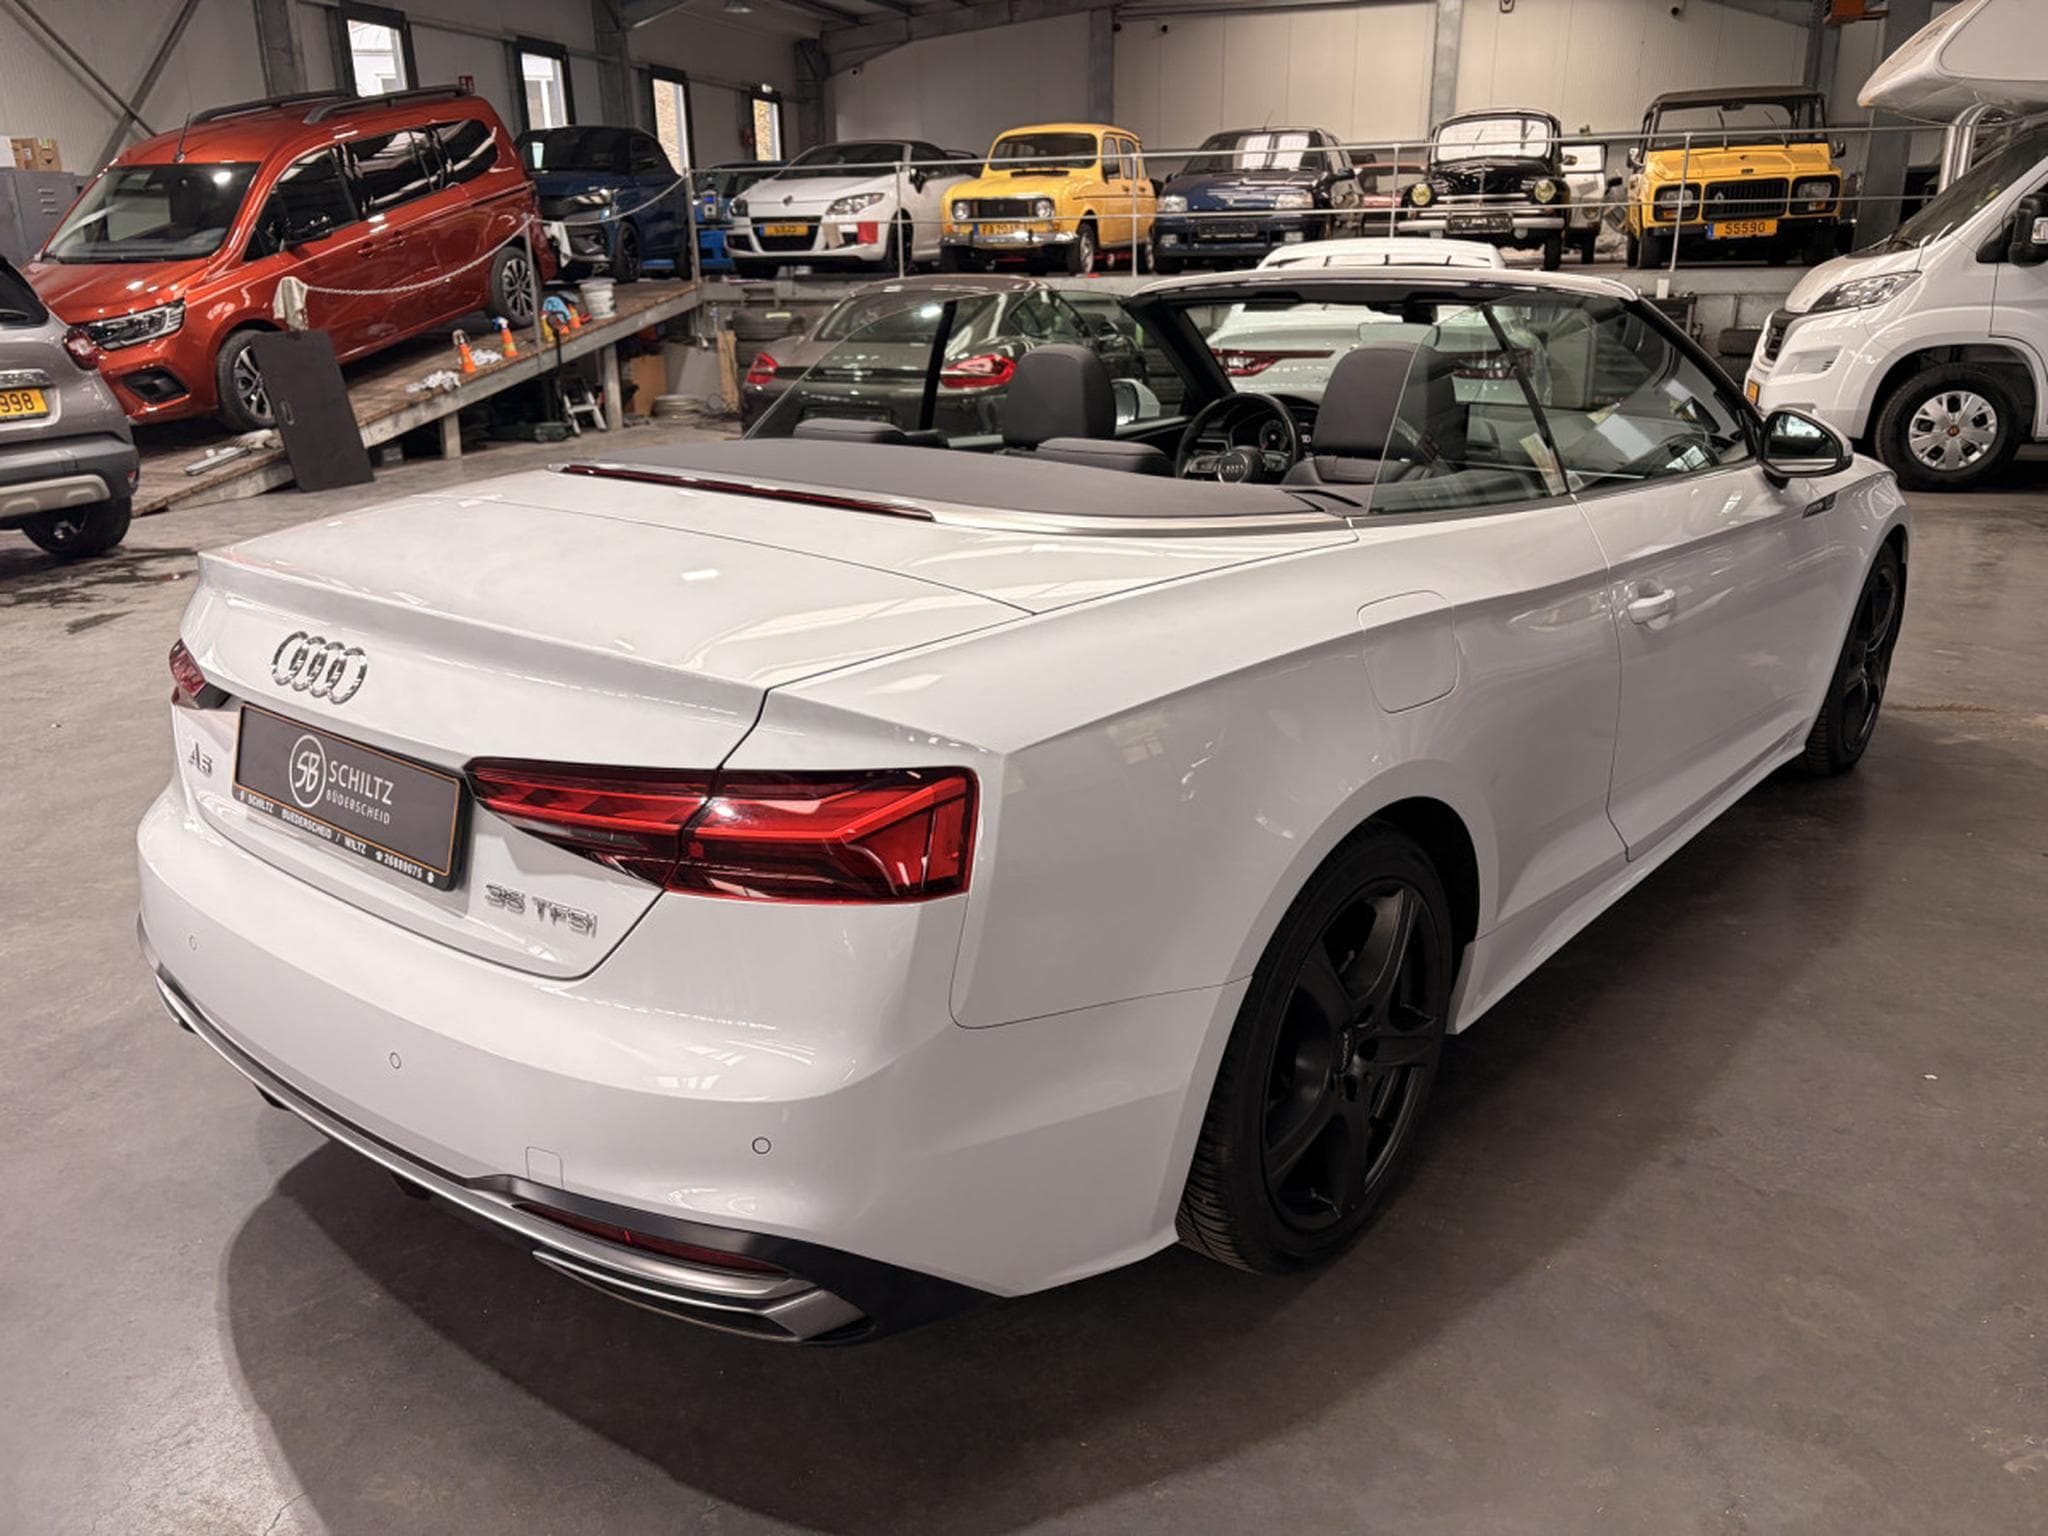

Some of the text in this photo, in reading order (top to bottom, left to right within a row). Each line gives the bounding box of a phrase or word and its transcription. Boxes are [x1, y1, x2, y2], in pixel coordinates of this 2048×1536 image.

[1725, 221, 1766, 235] 55590
[0, 391, 35, 412] 998
[188, 740, 213, 778] A5
[328, 760, 394, 805] SCHILTZ
[247, 792, 275, 813] SCHILTZ
[344, 835, 367, 855] WILTZ
[484, 884, 526, 915] 35
